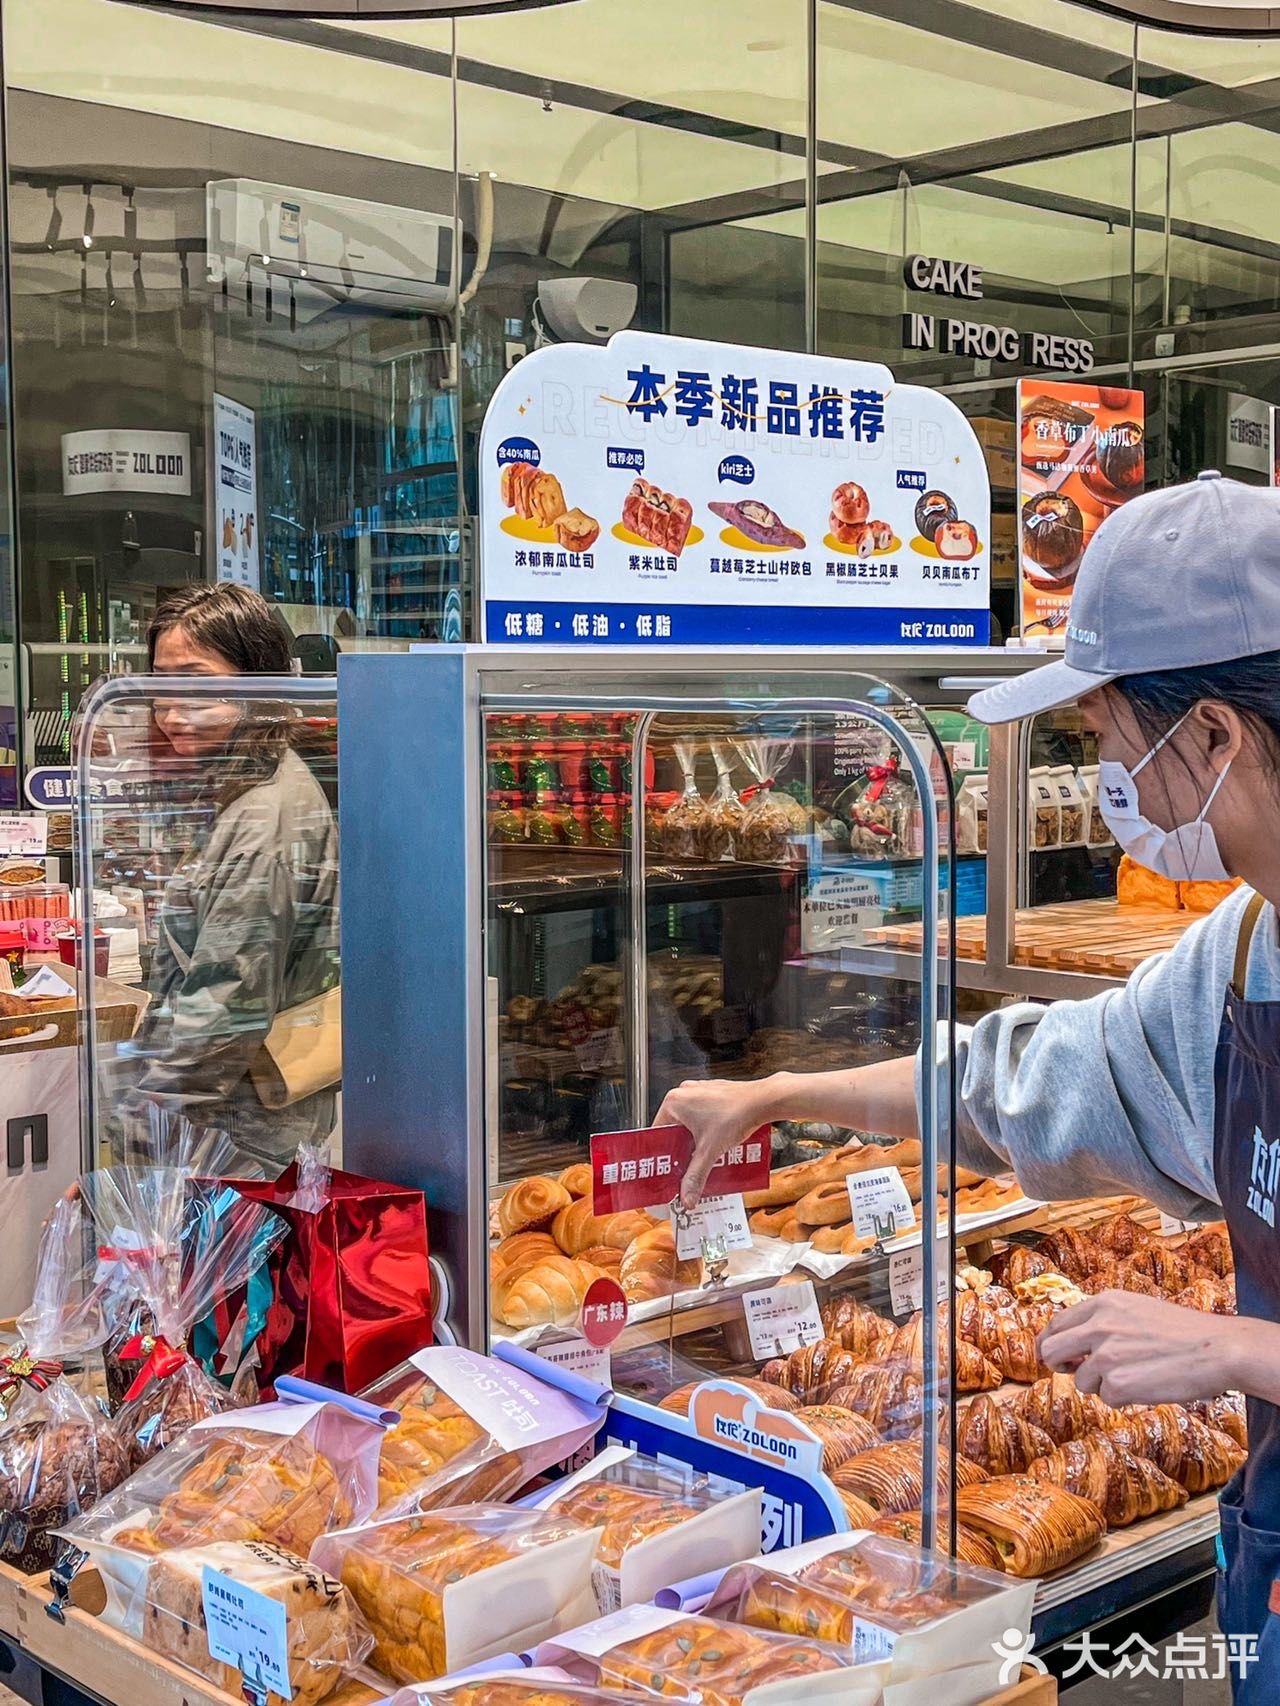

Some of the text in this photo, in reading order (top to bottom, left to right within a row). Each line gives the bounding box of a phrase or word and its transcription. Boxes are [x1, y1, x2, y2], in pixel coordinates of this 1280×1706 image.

[909, 255, 983, 298] CAKE
[910, 313, 934, 348] IN
[626, 364, 885, 443] 本季新品推荐
[1035, 421, 1131, 448] 香草布丁小南瓜
[498, 446, 540, 461] 含40%南瓜
[608, 450, 644, 466] 推荐必吃
[132, 453, 183, 476] ZOLOON
[720, 462, 753, 478] kiri芝士
[515, 551, 594, 569] 浓郁南瓜吐司
[629, 555, 678, 572] 紫米吐司
[709, 558, 812, 576] 蔓越莓芝士山村欧包
[825, 562, 899, 578] 黑椒肠芝士贝果
[922, 565, 981, 581] 贝贝南瓜布丁
[504, 612, 672, 637] 低糖 低油 低脂
[926, 624, 974, 638] ZOLOON
[584, 1300, 625, 1326] 广东辣
[449, 1354, 540, 1432] TOAST 吐司
[743, 1428, 797, 1460] ZOLOON
